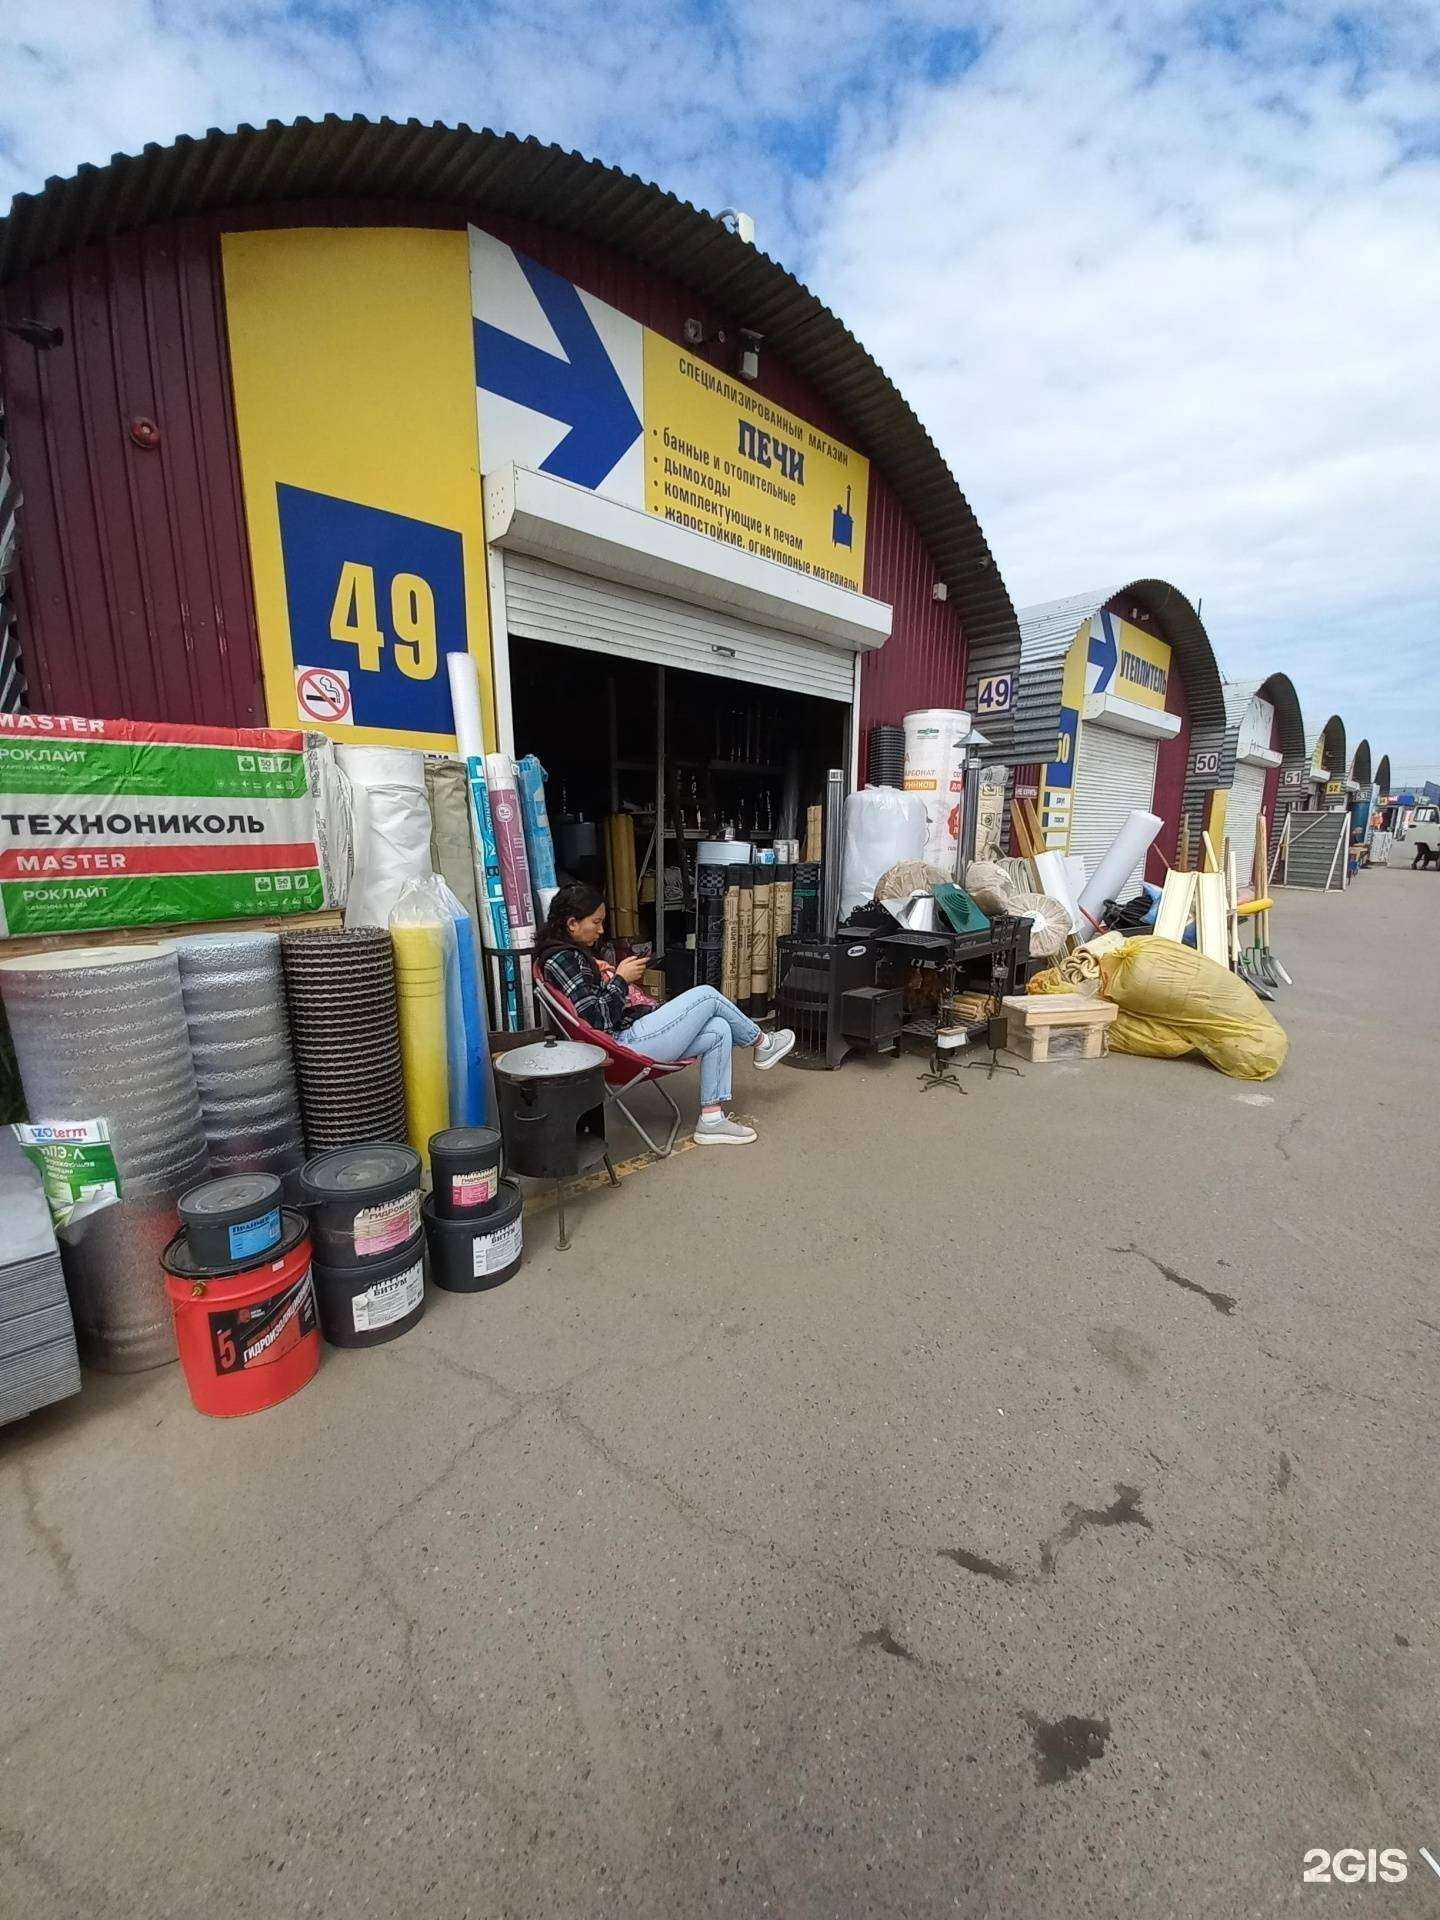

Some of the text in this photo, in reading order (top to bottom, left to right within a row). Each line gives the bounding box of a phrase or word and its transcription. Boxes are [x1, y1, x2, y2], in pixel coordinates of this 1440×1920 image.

[679, 357, 849, 467] СПЕЦИАЛИЗИРОВАННЫЙ МАГАЗИН
[663, 427, 797, 506] банные и отопительные
[738, 418, 805, 486] ПЕЧИ
[664, 457, 732, 498] дымоходы
[664, 481, 804, 550] комплектующие к печам
[748, 539, 812, 575] огнеупорные
[812, 565, 860, 592] материалы
[329, 560, 438, 681] 49
[1120, 648, 1168, 696] УТЕПЛИТЕЛЬ
[980, 679, 1010, 708] 49
[0, 714, 105, 733] MASTER
[1196, 755, 1218, 772] 50
[1286, 772, 1301, 784] 51
[1, 814, 265, 835] ТЕХНОНИКОЛЬ
[16, 853, 127, 872] MASTER
[23, 884, 109, 902] РОКЛАЙТ
[373, 1277, 408, 1297] БИТУМ
[216, 1330, 237, 1370] 5
